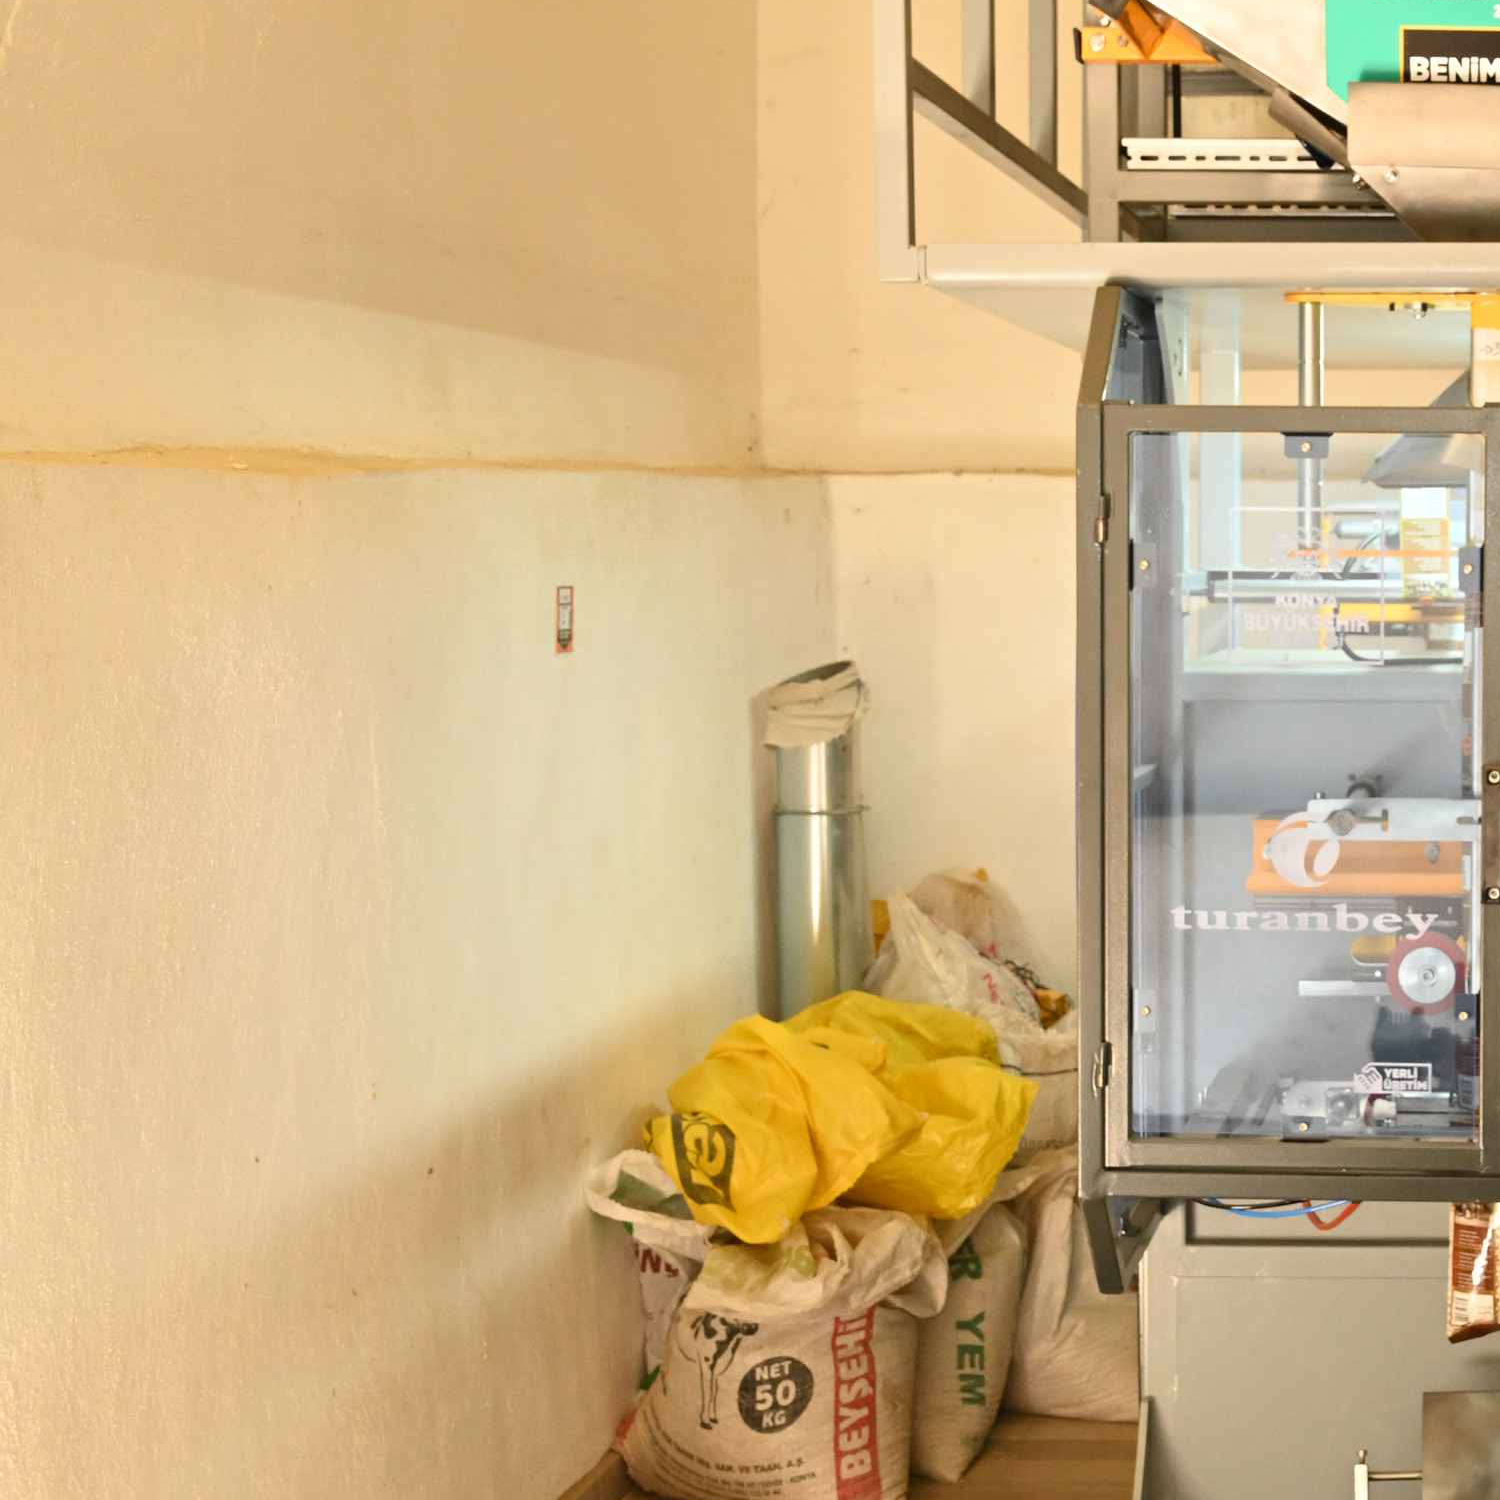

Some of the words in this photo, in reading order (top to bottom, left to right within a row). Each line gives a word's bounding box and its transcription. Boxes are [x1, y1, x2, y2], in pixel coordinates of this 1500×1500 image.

[1275, 593, 1338, 608] KONYA
[1171, 903, 1439, 940] turanbey
[1384, 1066, 1418, 1079] YERLİ
[1383, 1078, 1428, 1091] ÜRETİM
[956, 1310, 987, 1406] YEM
[754, 1360, 793, 1382] NET
[755, 1379, 797, 1412] 50
[838, 1316, 874, 1480] BEYŞEHİ
[761, 1409, 787, 1429] KG
